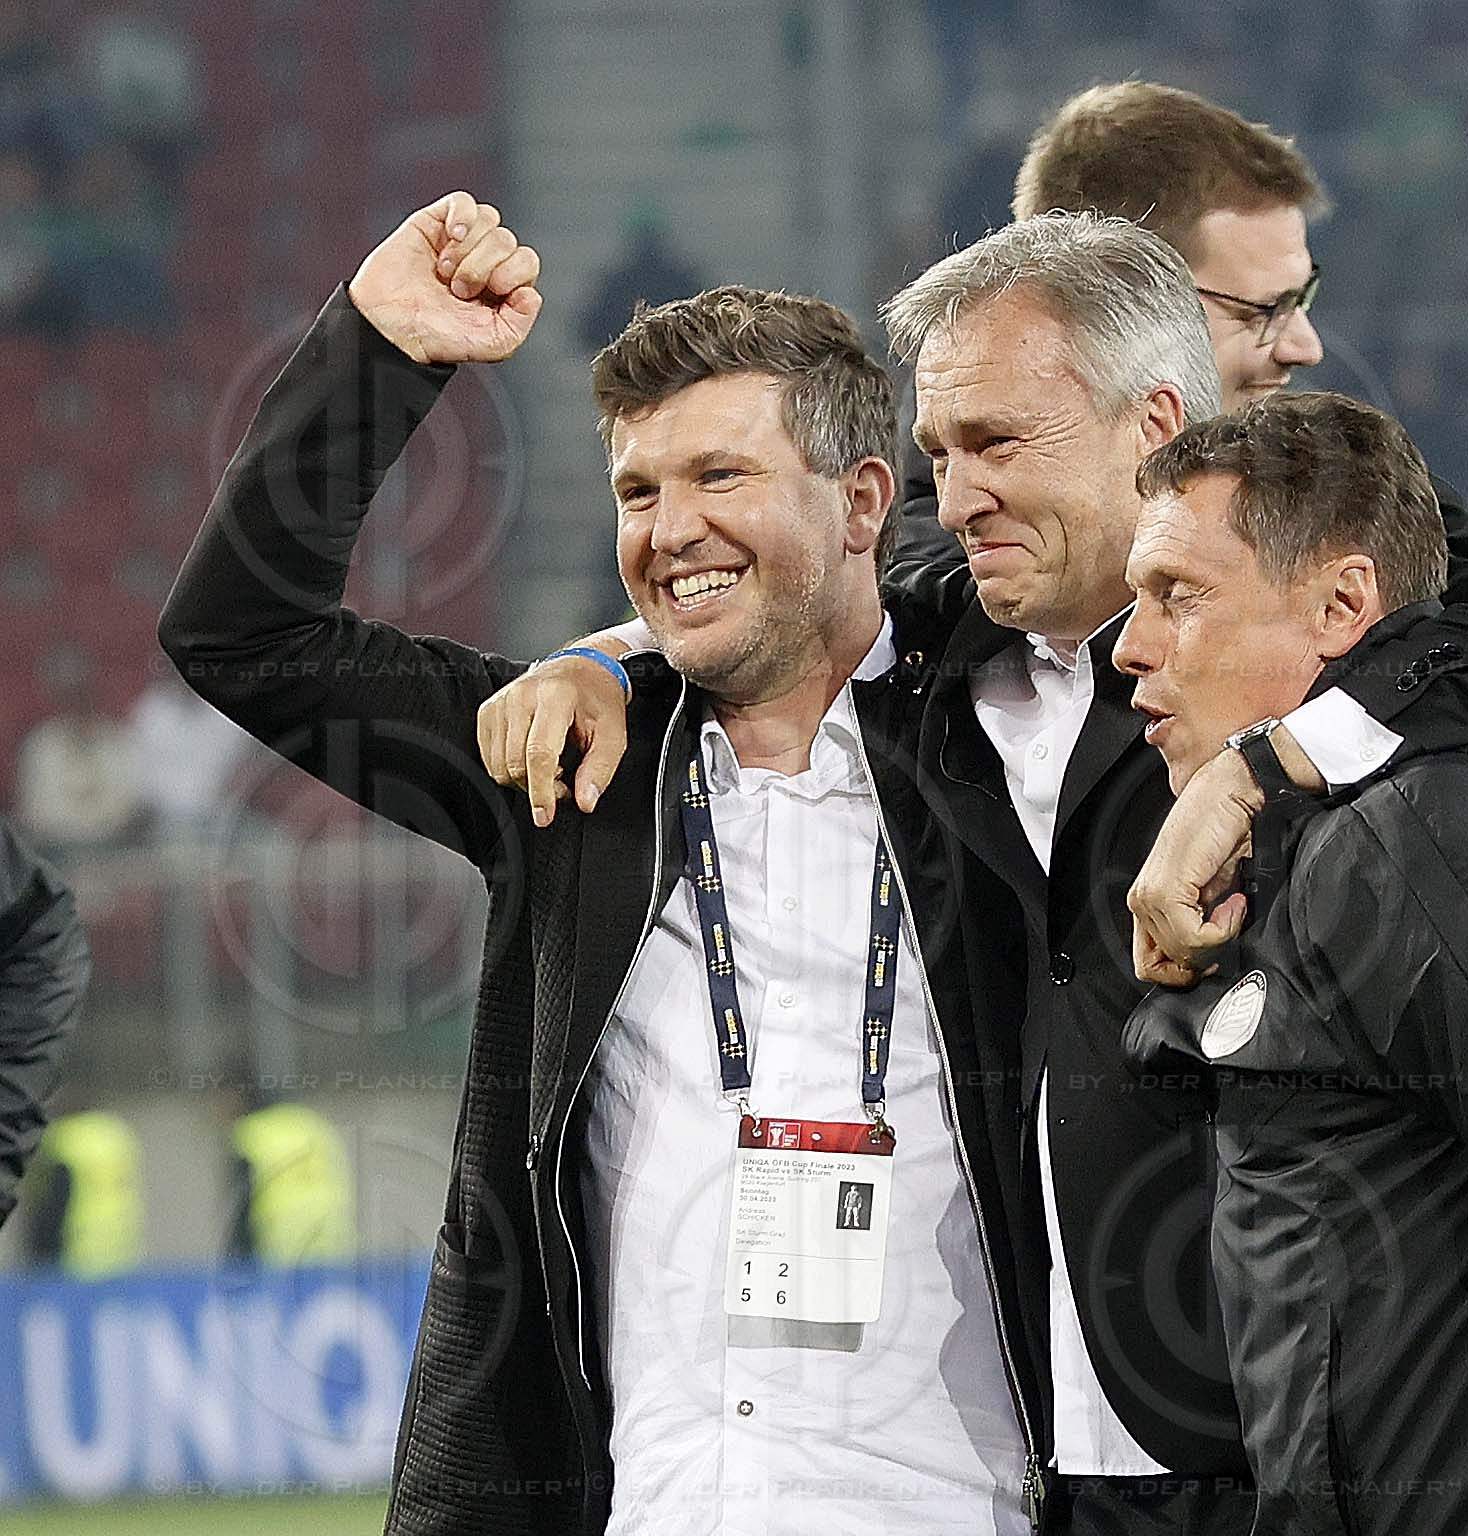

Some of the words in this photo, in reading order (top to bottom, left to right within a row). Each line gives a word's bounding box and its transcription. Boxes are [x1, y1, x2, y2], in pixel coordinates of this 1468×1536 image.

[743, 1157, 769, 1166] UNIQA
[792, 1160, 808, 1169] Cup
[836, 1163, 855, 1171] 2023
[744, 1261, 752, 1275] 1
[778, 1263, 789, 1277] 2
[741, 1288, 752, 1302] 5
[776, 1290, 787, 1305] 6
